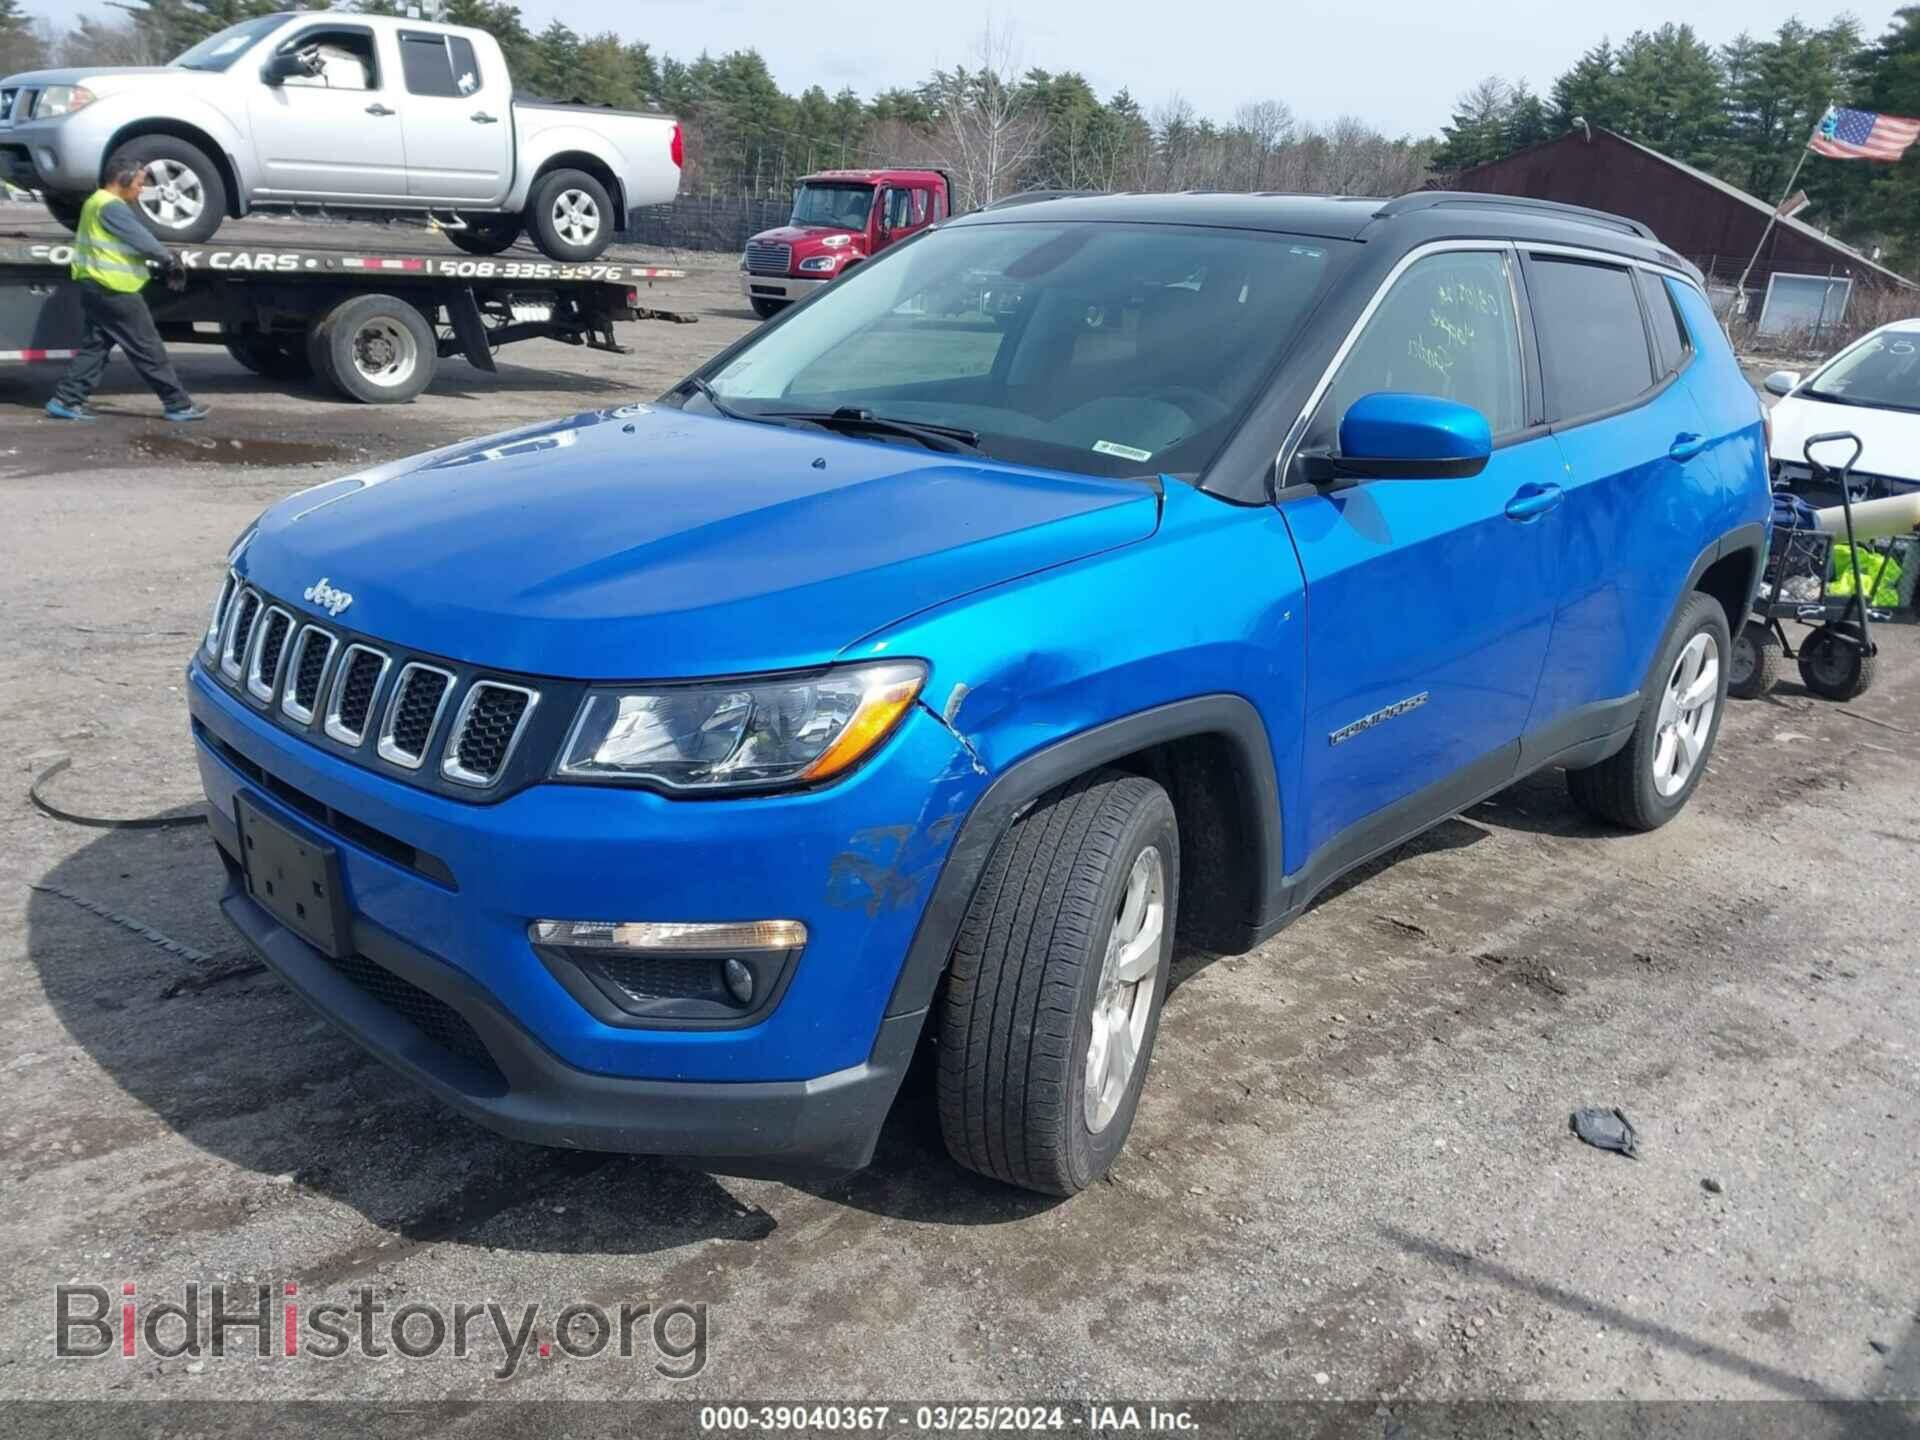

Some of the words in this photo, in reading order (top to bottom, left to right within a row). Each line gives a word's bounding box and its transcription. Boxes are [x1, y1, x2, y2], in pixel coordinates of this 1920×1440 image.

[209, 252, 300, 270] CARS
[440, 261, 622, 280] 508-335-3976
[304, 577, 352, 616] Jeep
